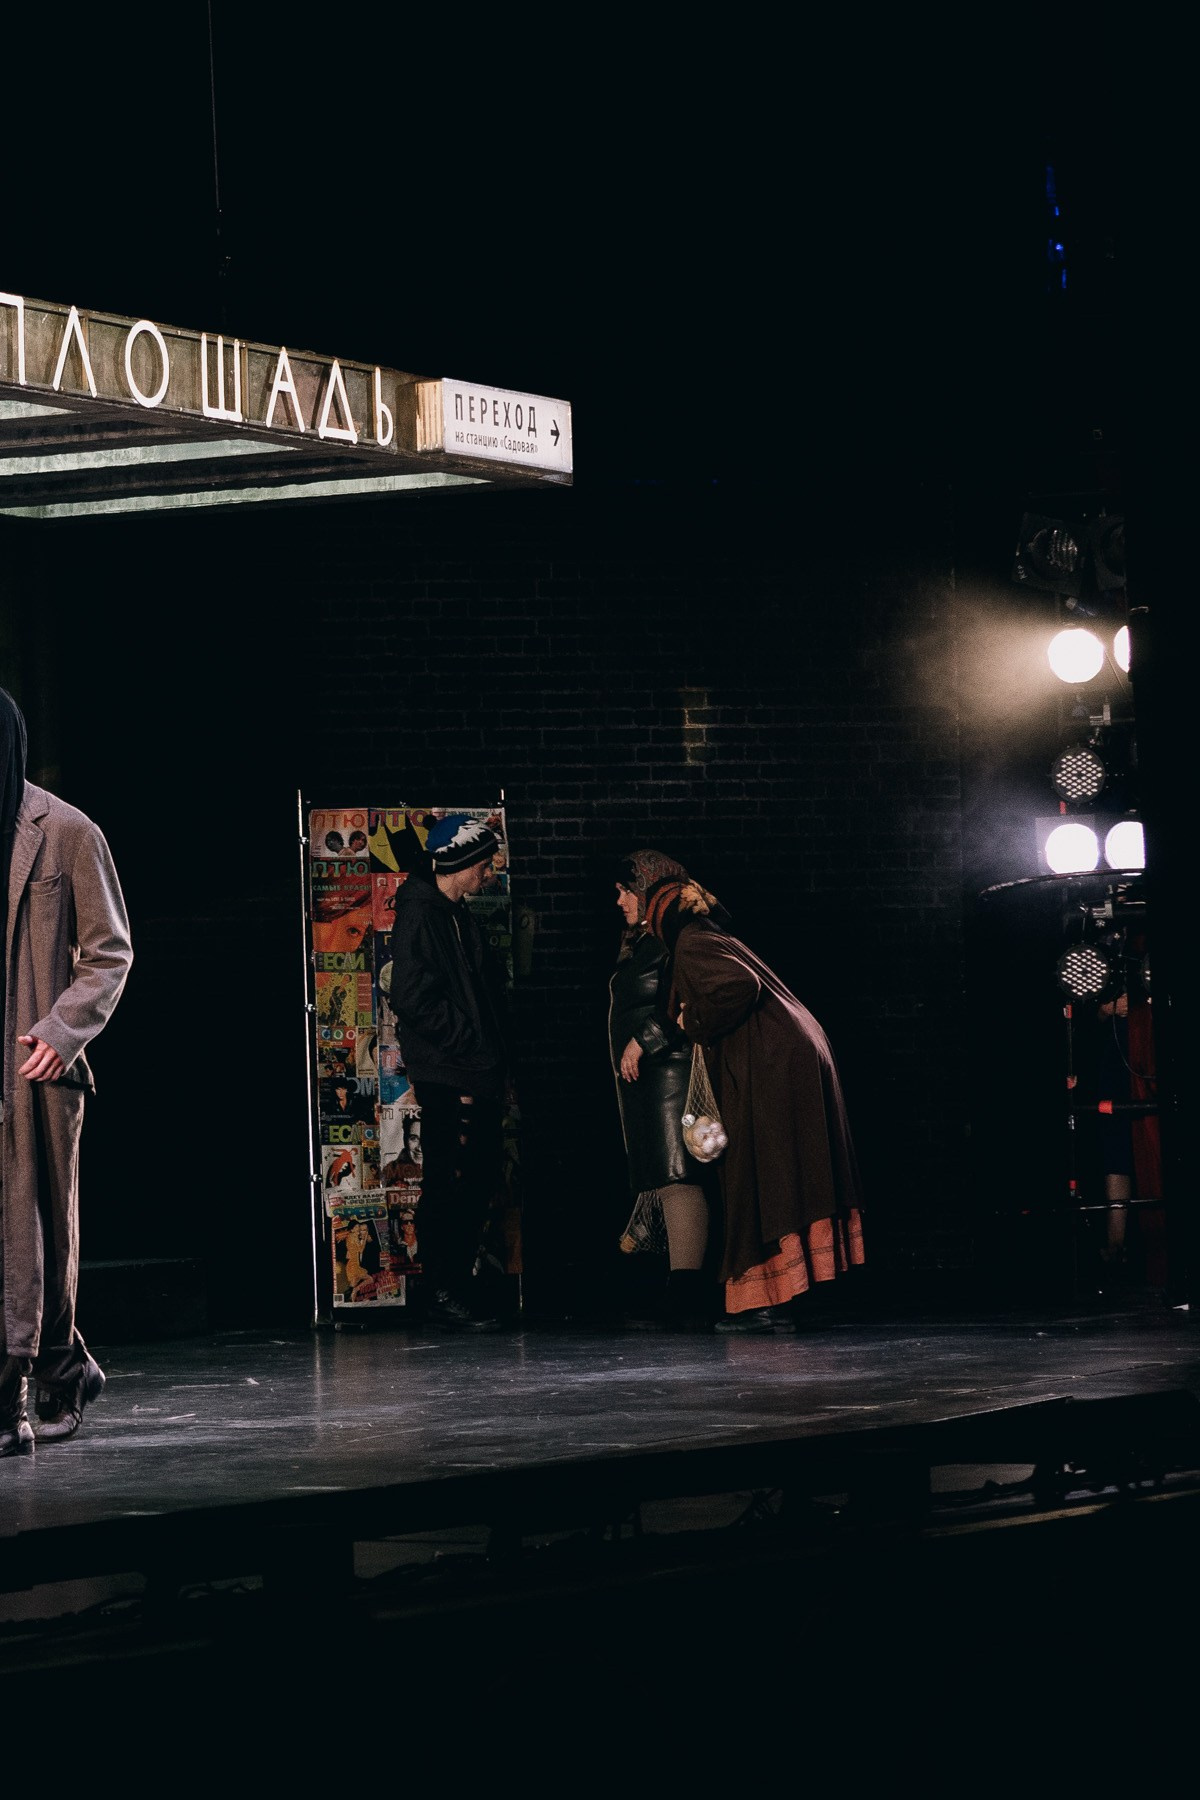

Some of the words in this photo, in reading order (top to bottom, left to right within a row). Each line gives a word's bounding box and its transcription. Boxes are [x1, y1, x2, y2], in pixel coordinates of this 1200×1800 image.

[455, 393, 537, 438] ПЕРЕХОД
[455, 431, 464, 443] на
[466, 433, 498, 449] станцию
[500, 435, 538, 454] «Садовая»
[323, 952, 365, 970] ЕСЛИ
